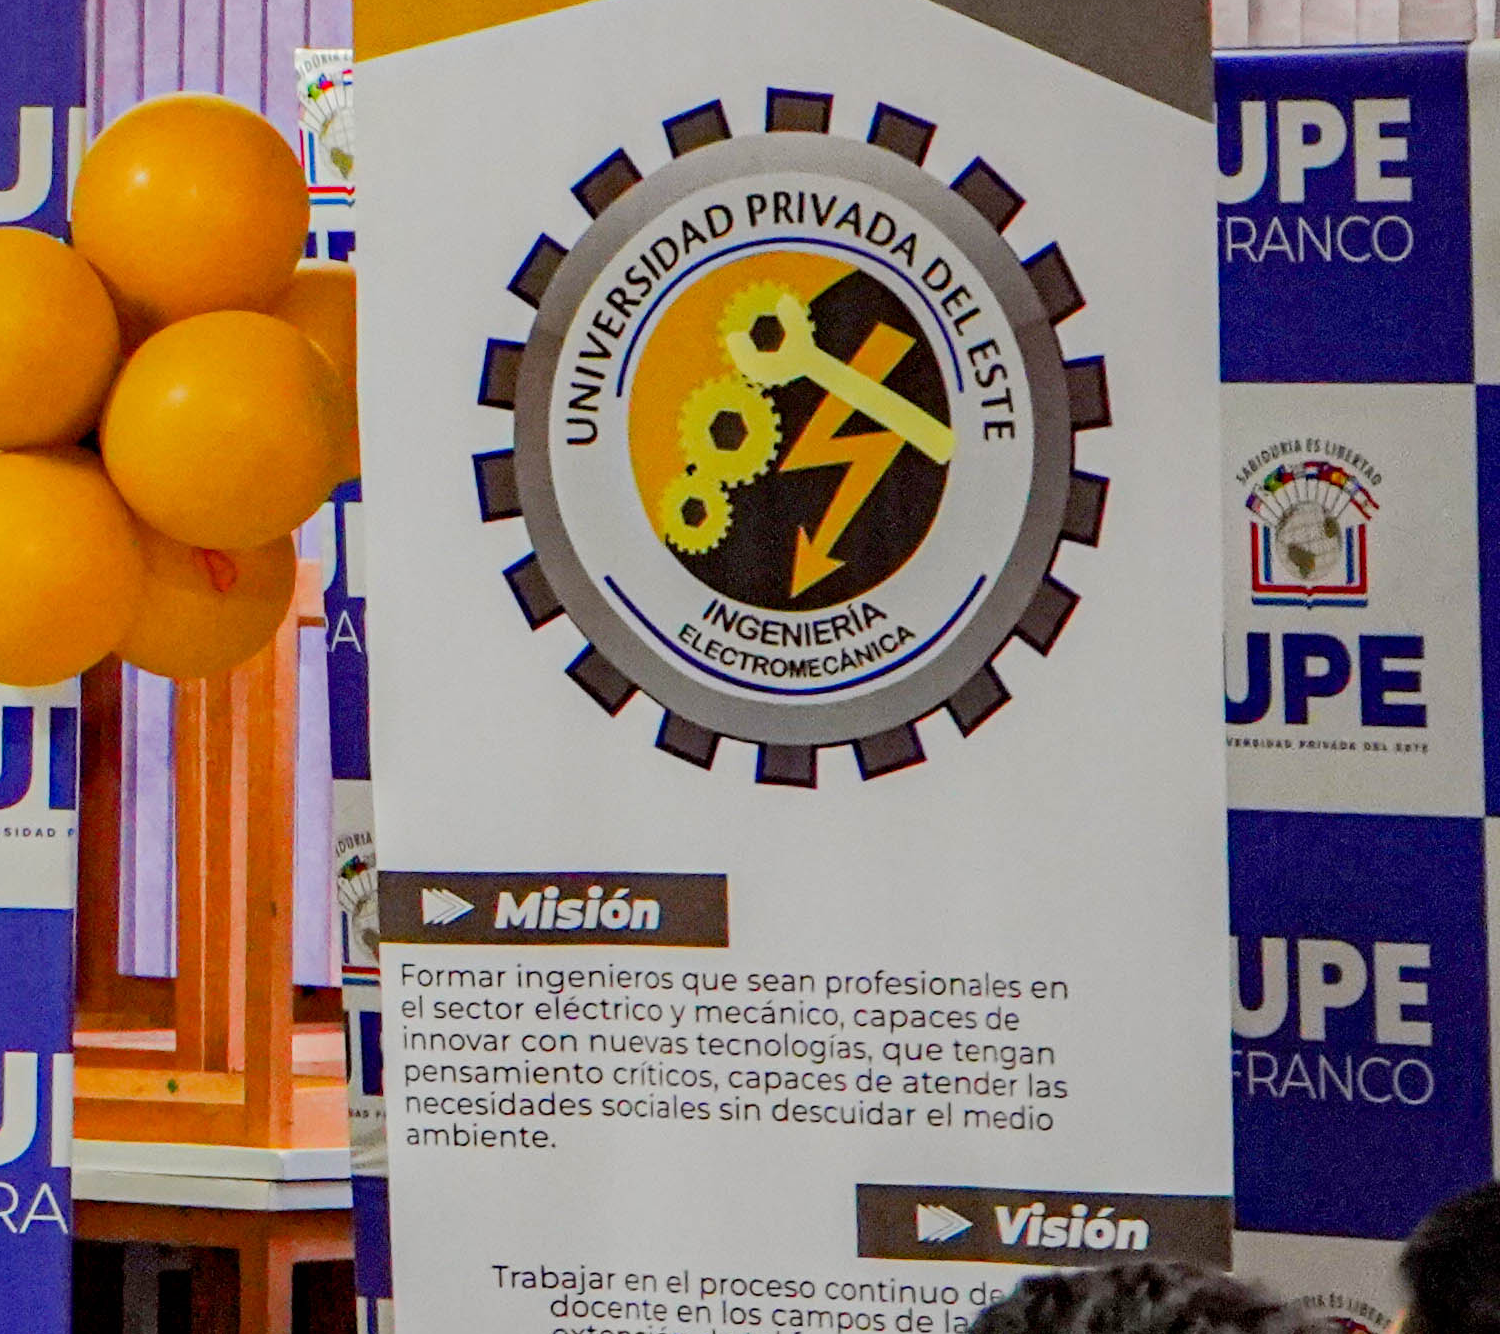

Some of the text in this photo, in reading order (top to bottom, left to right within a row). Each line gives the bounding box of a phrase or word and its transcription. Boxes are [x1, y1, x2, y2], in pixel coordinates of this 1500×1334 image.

[1224, 215, 1414, 263] RANCO
[566, 191, 1016, 446] UNIVERSIDAD PRIVADA DEL ESTE
[703, 598, 887, 648] INGENIERÍA
[678, 623, 916, 680] ELECTROMECÁNICA
[495, 885, 660, 930] Misión
[401, 963, 1068, 1000] Formar ingenieros que sean profesionales en
[1230, 936, 1433, 1047] UPE
[401, 995, 1020, 1035] el sector eléctrico y mecánico, capaces de
[404, 1025, 1055, 1070] innovar con nuevas tecnologías, que tengan
[405, 1059, 1068, 1099] pensamiento críticos, capaces de atender las
[406, 1091, 1053, 1131] necesidades sociales sin descuidar el medio
[406, 1123, 556, 1148] ambiente.
[995, 1202, 1149, 1251] Visión
[491, 1265, 616, 1295] Trabajar
[625, 1273, 657, 1292] en
[666, 1270, 689, 1294] el
[700, 1277, 815, 1300] proceso
[825, 1278, 959, 1305] continuo
[550, 1293, 668, 1320] docente
[676, 1305, 711, 1323] en
[722, 1300, 762, 1326] los
[771, 1308, 886, 1334] campos
[895, 1307, 934, 1333] de
